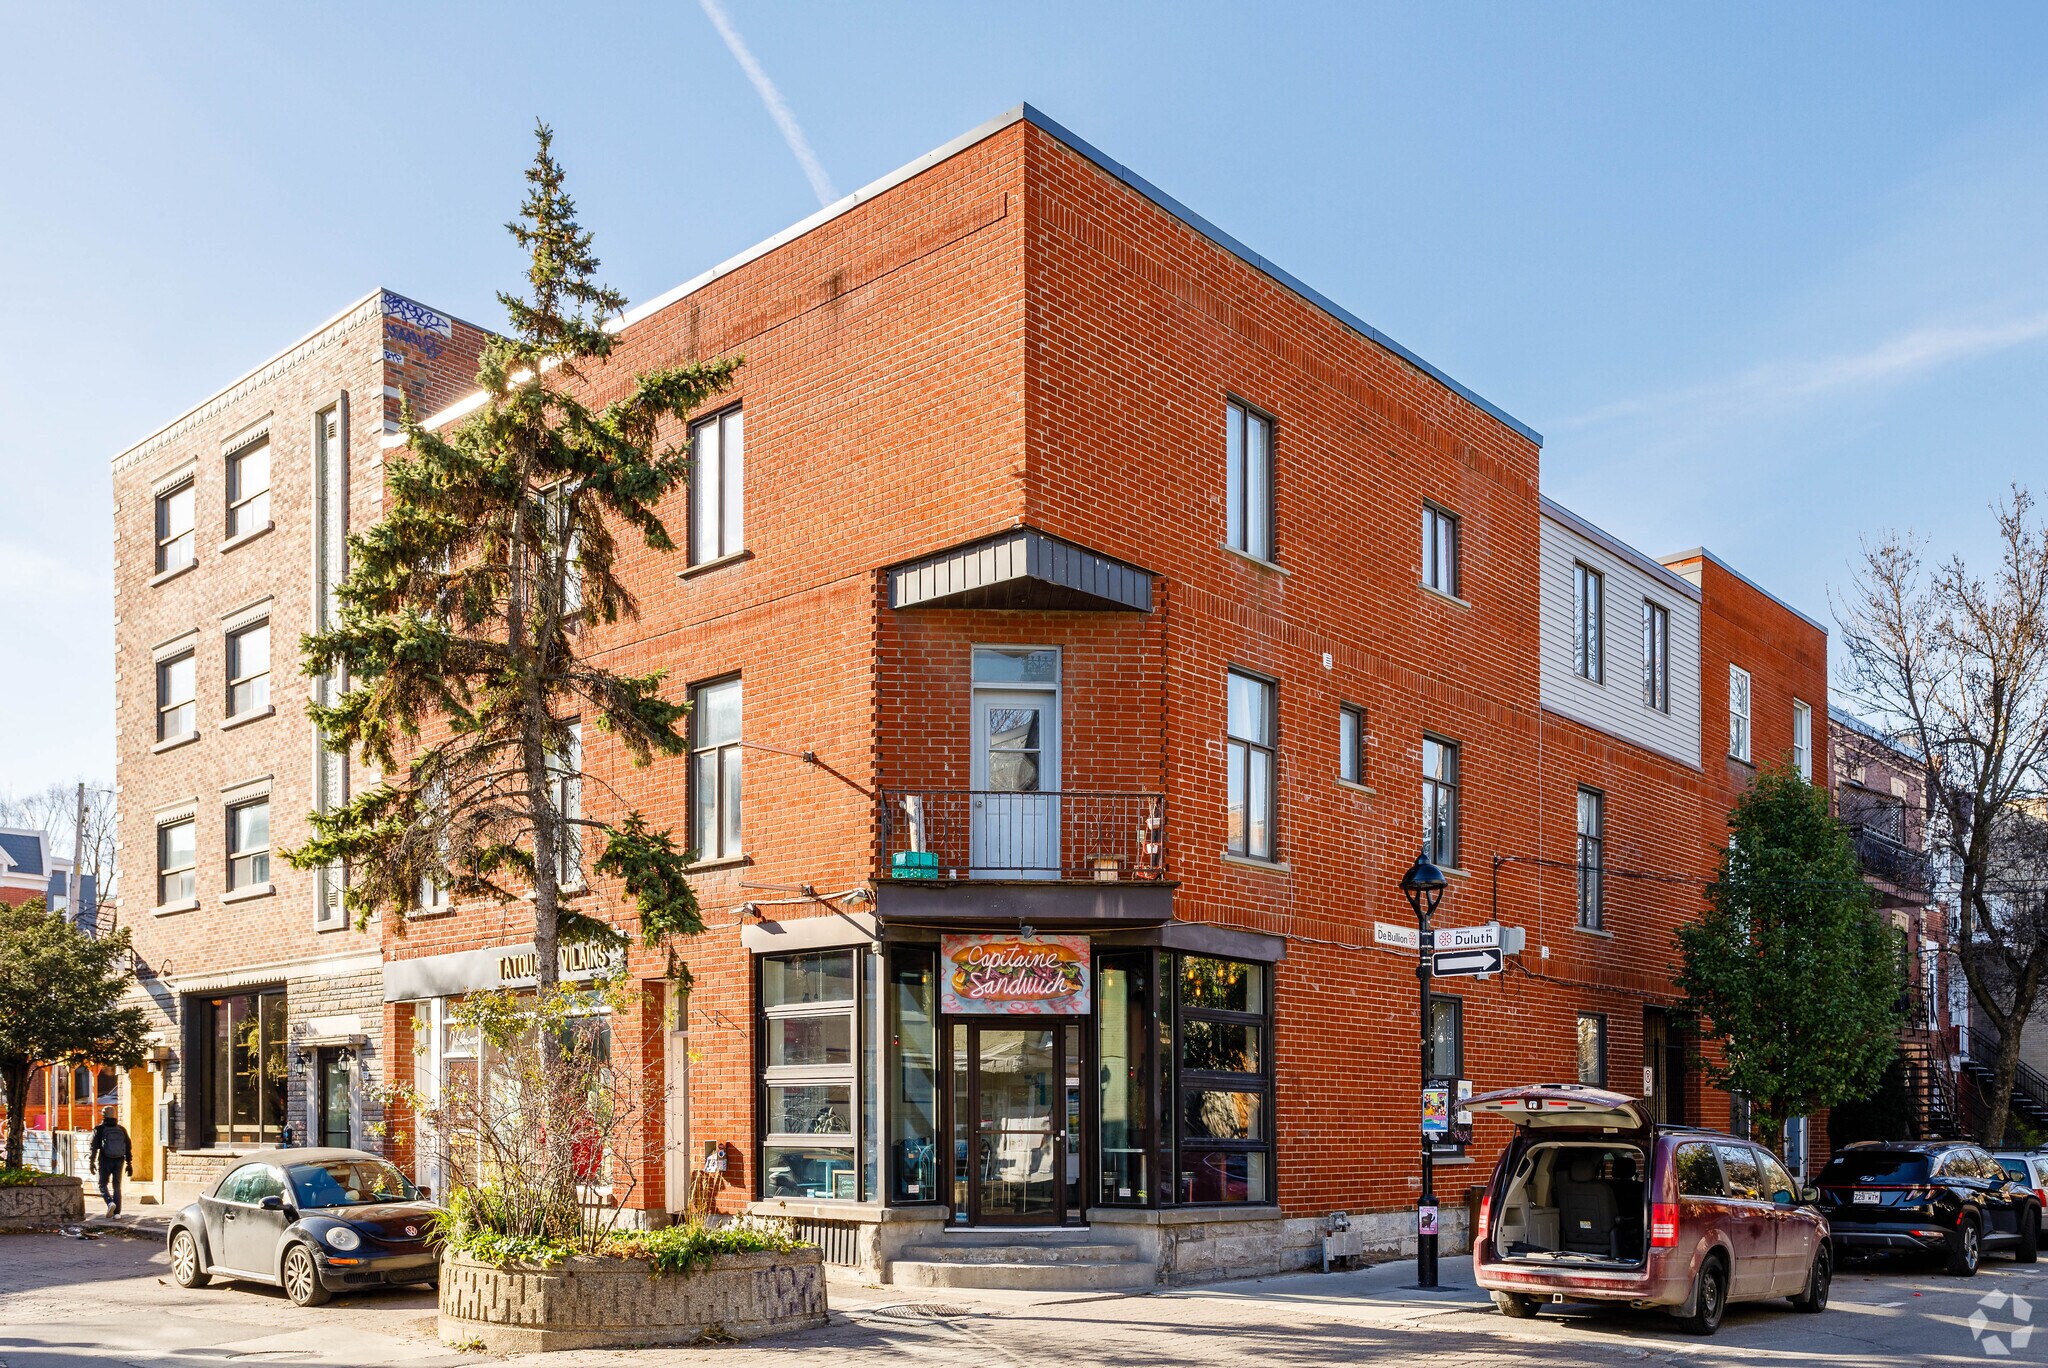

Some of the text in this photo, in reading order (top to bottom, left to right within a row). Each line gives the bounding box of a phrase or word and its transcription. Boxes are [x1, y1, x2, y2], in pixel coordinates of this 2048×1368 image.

[1378, 929, 1408, 944] De Bullion
[1455, 933, 1493, 945] Duluth
[560, 944, 608, 972] VILAINS
[968, 944, 1062, 979] Capitaine
[969, 970, 1068, 997] Sandwich
